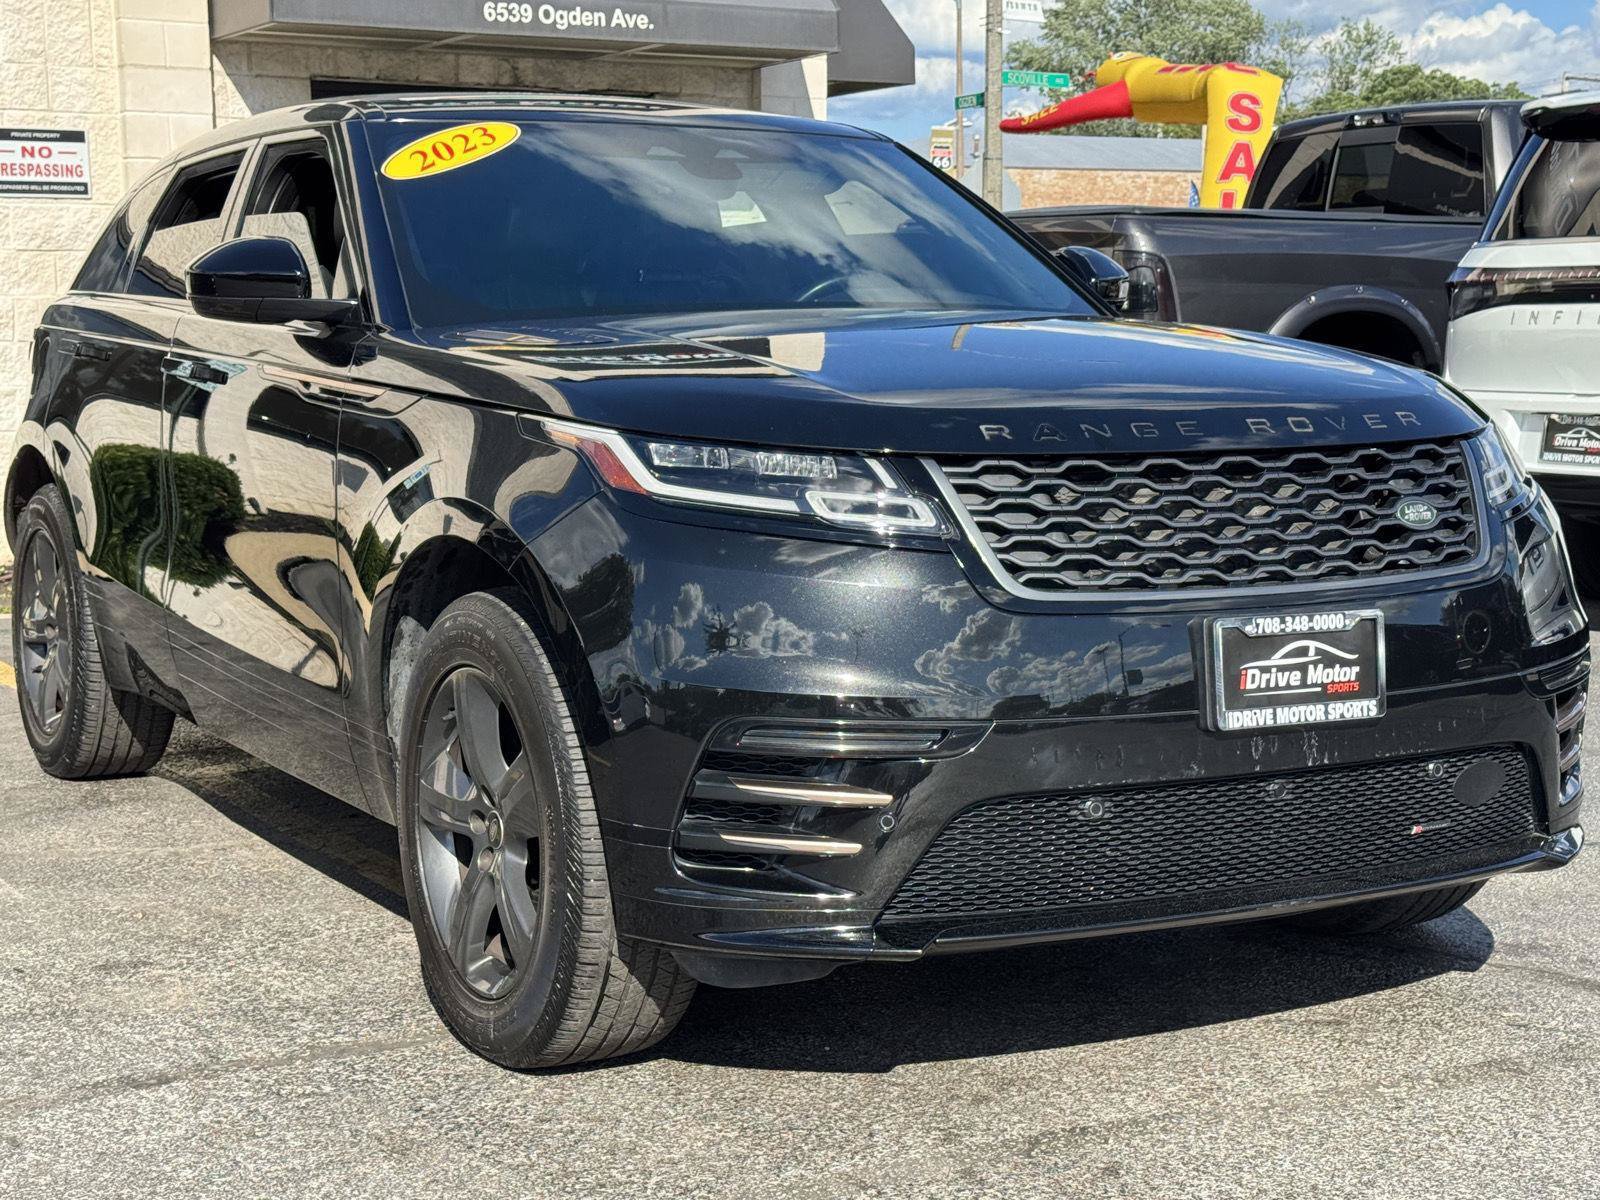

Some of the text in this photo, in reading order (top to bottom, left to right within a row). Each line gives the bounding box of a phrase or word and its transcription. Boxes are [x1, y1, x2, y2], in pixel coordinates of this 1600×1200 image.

[483, 1, 655, 30] 6539 Ogden Ave.
[1007, 72, 1049, 86] SCOVILLE
[21, 145, 52, 159] NO
[409, 126, 497, 172] 2023
[0, 162, 84, 178] RESPASSING
[932, 156, 951, 169] 66
[979, 411, 1422, 442] RANGE ROVER
[1409, 511, 1432, 521] ROVER
[1256, 613, 1344, 634] 708-348-0000
[1239, 664, 1360, 690] iDrive Motor
[1326, 682, 1360, 694] SPORTS
[1276, 704, 1326, 724] MOTOR
[1328, 700, 1378, 720] SPORTS
